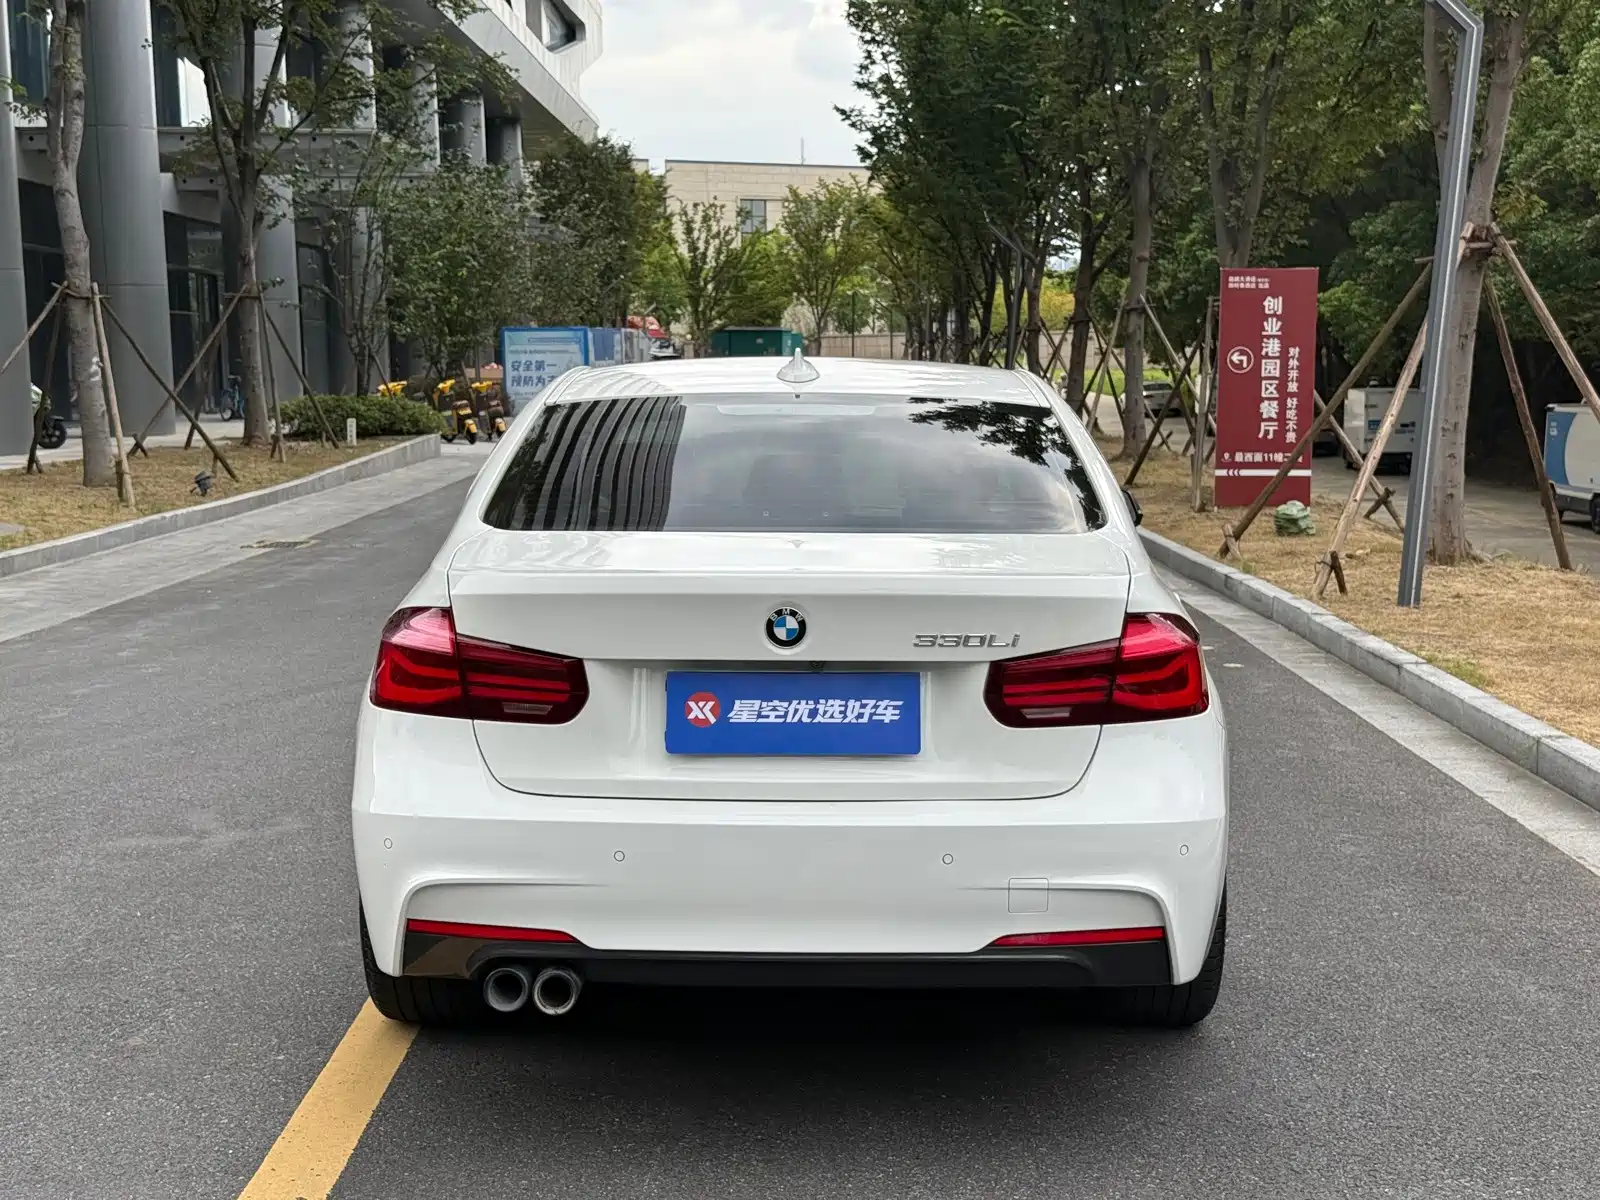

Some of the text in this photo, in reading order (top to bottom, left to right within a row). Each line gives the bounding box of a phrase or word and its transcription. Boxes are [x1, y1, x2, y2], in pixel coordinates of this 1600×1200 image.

[511, 360, 557, 372] 安全第一
[1258, 296, 1283, 440] 创业港园区餐厅
[1285, 346, 1300, 444] 对外开放 好吃不贵
[1234, 452, 1303, 463] 最西面11幢二
[912, 632, 1020, 648] 330Li
[727, 699, 904, 724] 星空优选好车
